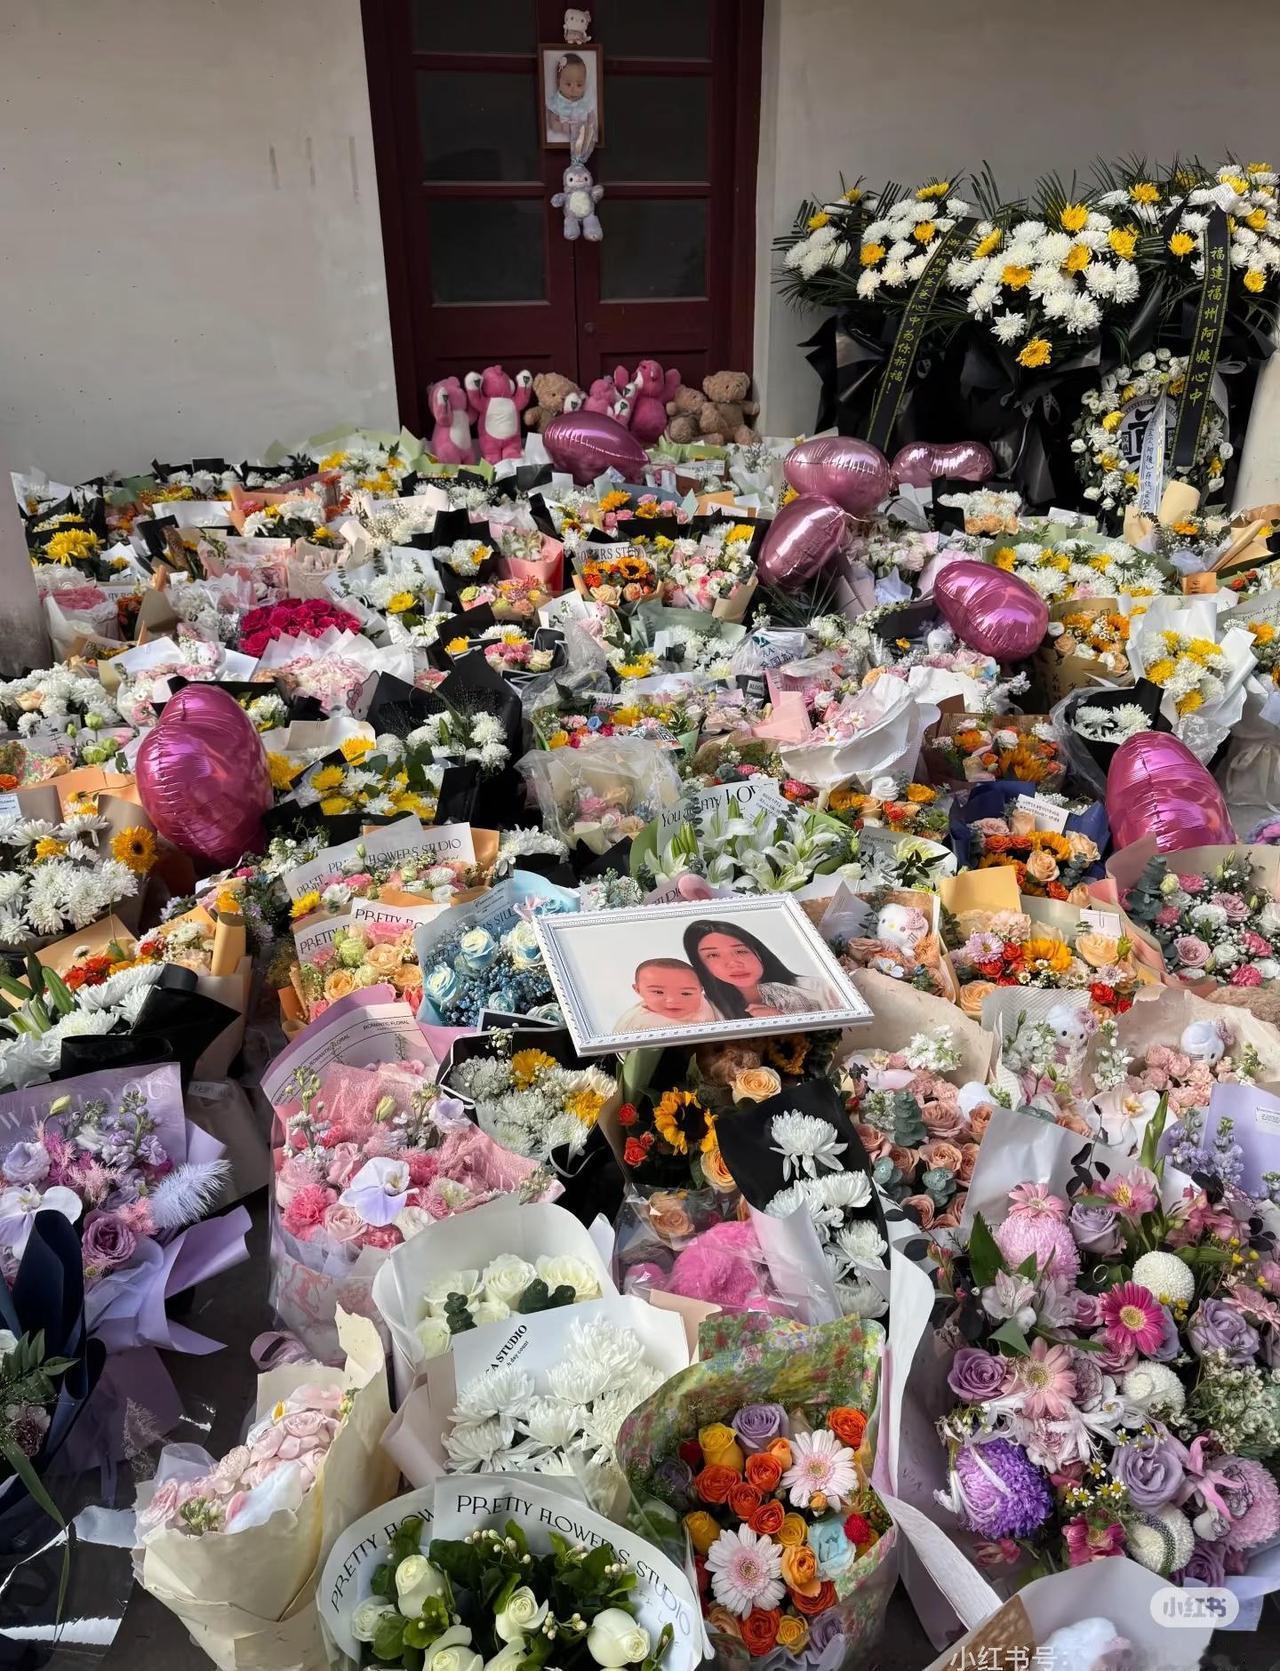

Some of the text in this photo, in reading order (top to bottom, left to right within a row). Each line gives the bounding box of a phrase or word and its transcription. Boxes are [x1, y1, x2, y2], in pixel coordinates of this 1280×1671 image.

[1187, 245, 1225, 408] 福建福州阿姨心中
[662, 811, 681, 827] You
[495, 1325, 527, 1363] STUDIO
[330, 1534, 378, 1613] PRETTY
[456, 1494, 533, 1516] PRETTY
[539, 1507, 631, 1566] FLOWERS
[636, 1560, 691, 1636] STUDIO
